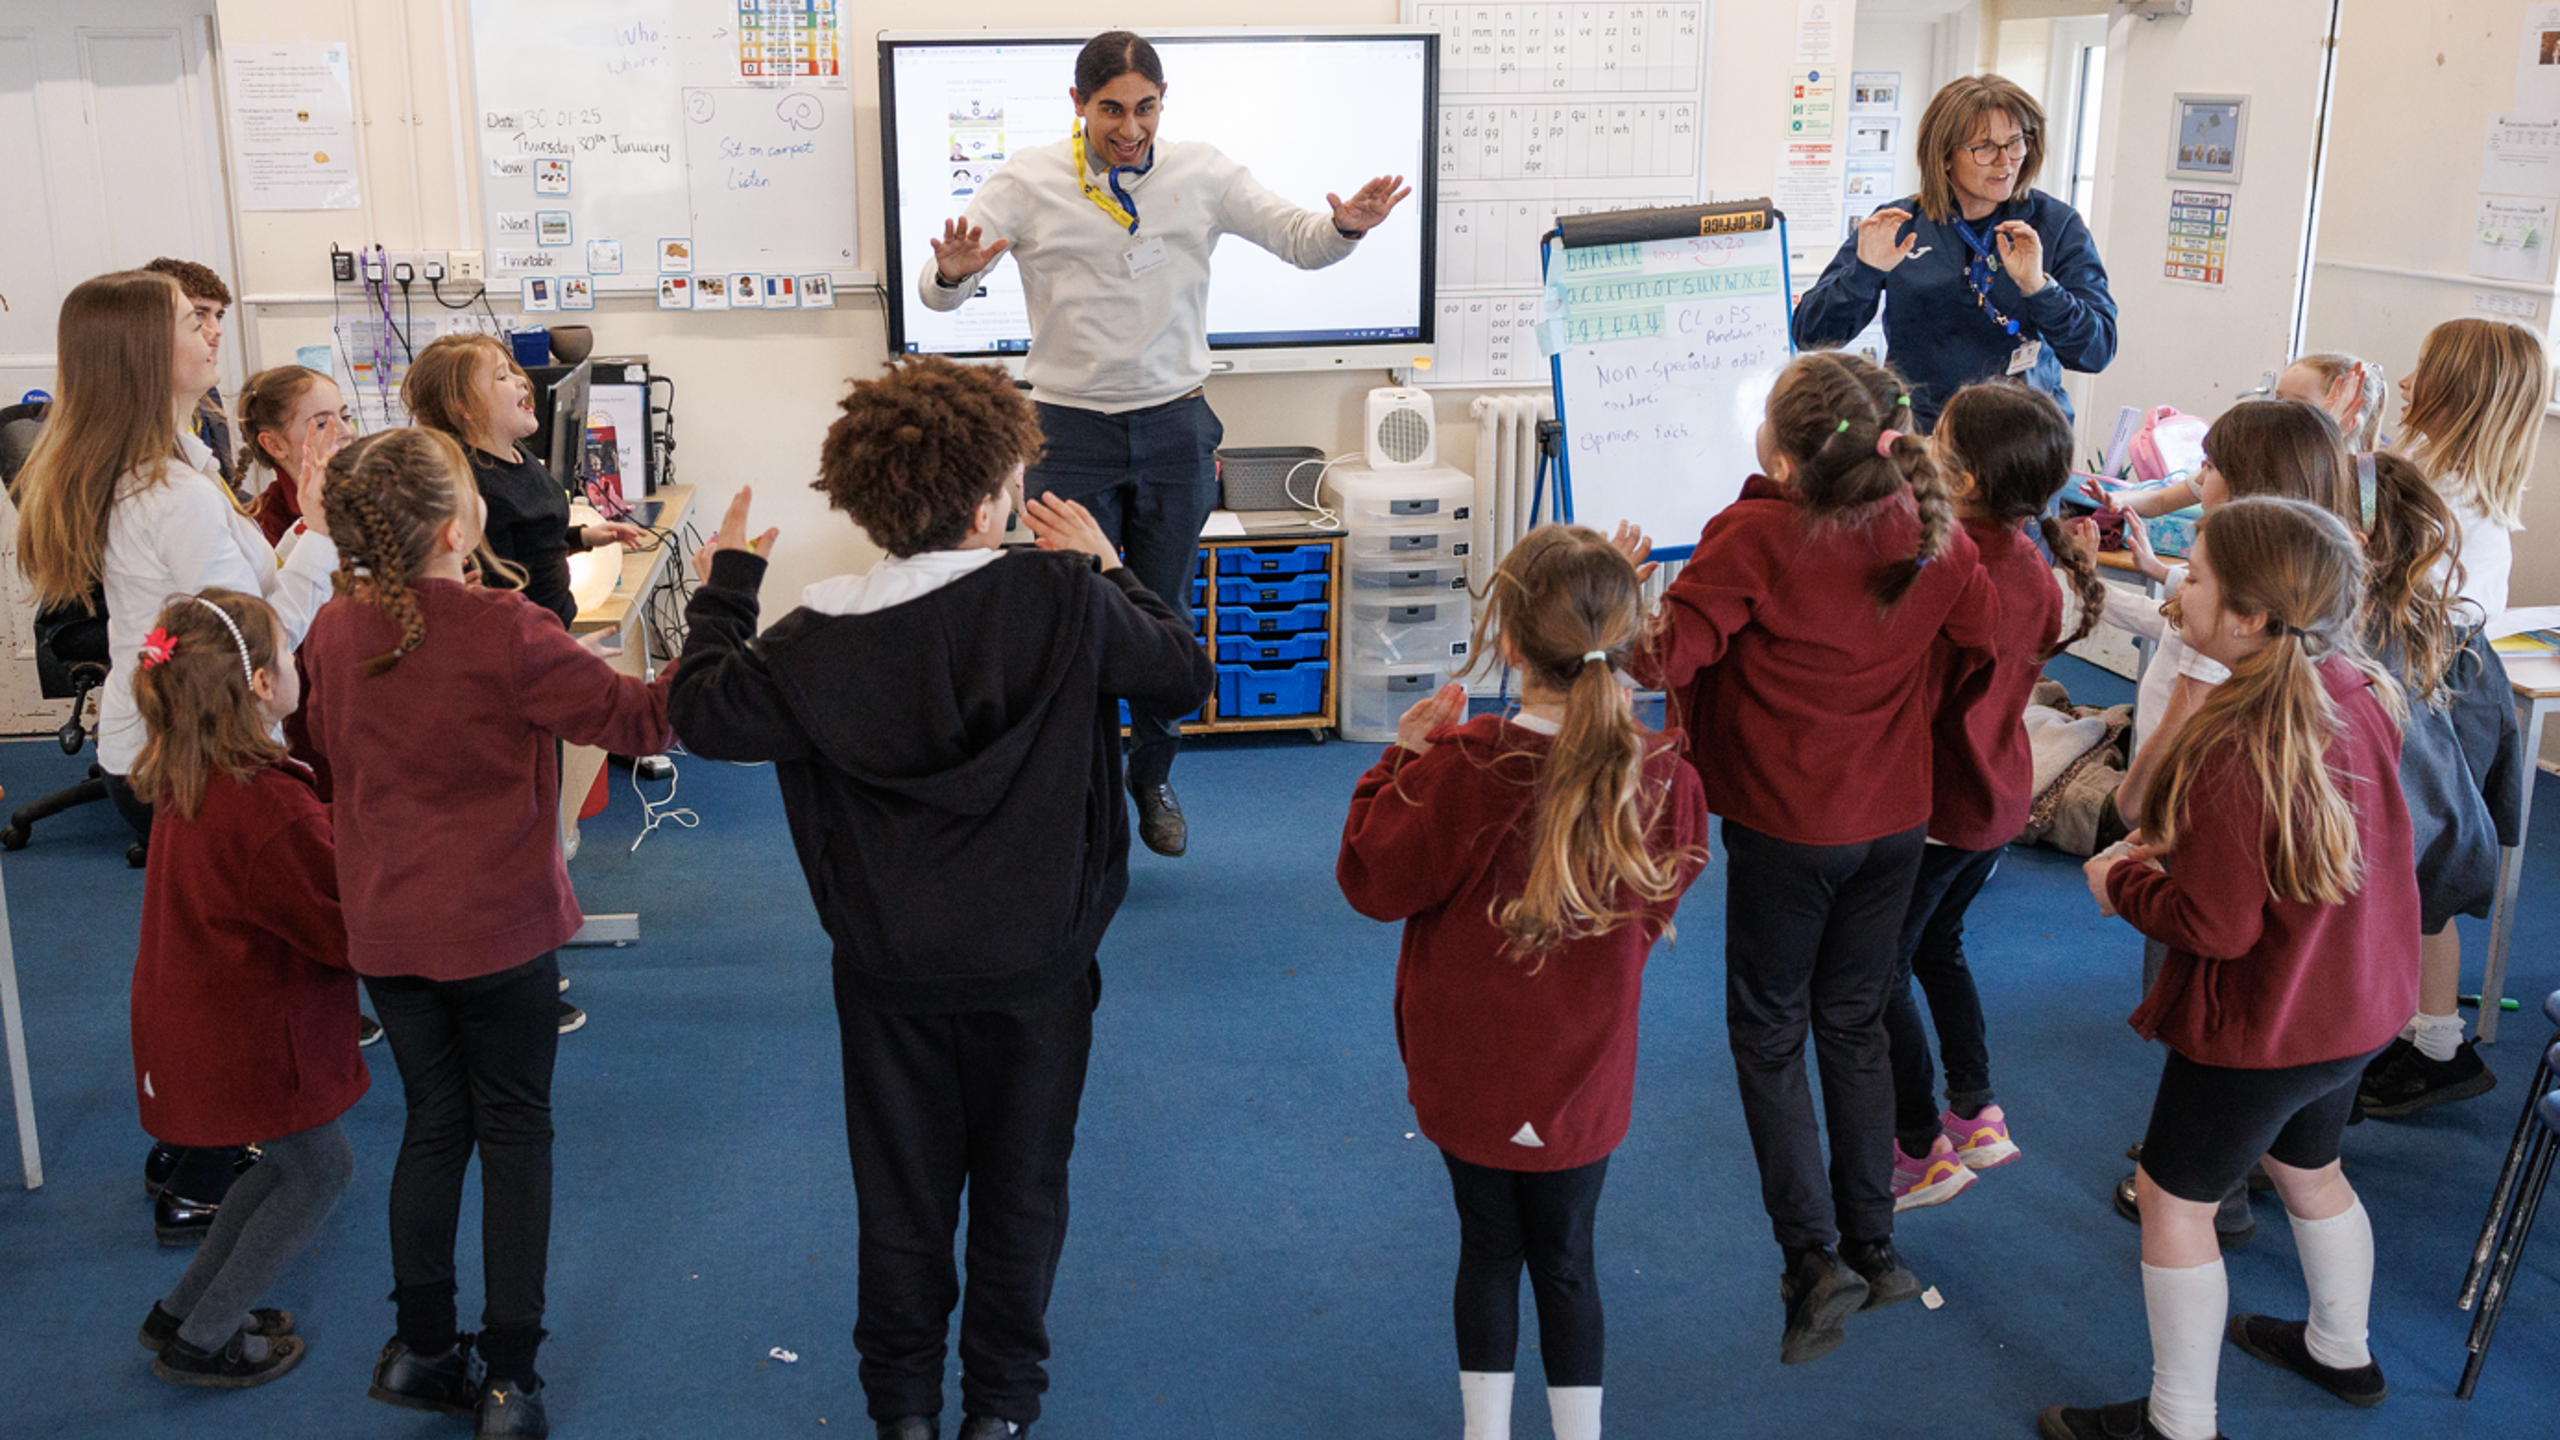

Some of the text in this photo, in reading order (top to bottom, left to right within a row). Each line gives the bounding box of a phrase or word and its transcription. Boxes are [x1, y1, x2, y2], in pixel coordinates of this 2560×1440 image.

[1476, 12, 1488, 20] m
[1505, 11, 1512, 20] n
[1532, 11, 1537, 20] r
[1582, 11, 1589, 19] v
[1630, 8, 1644, 19] sh
[1656, 8, 1669, 19] th
[1501, 28, 1515, 37] nn
[1579, 28, 1592, 36] ve
[513, 131, 576, 162] Thursday
[611, 133, 671, 164] January
[727, 167, 771, 191] Listen
